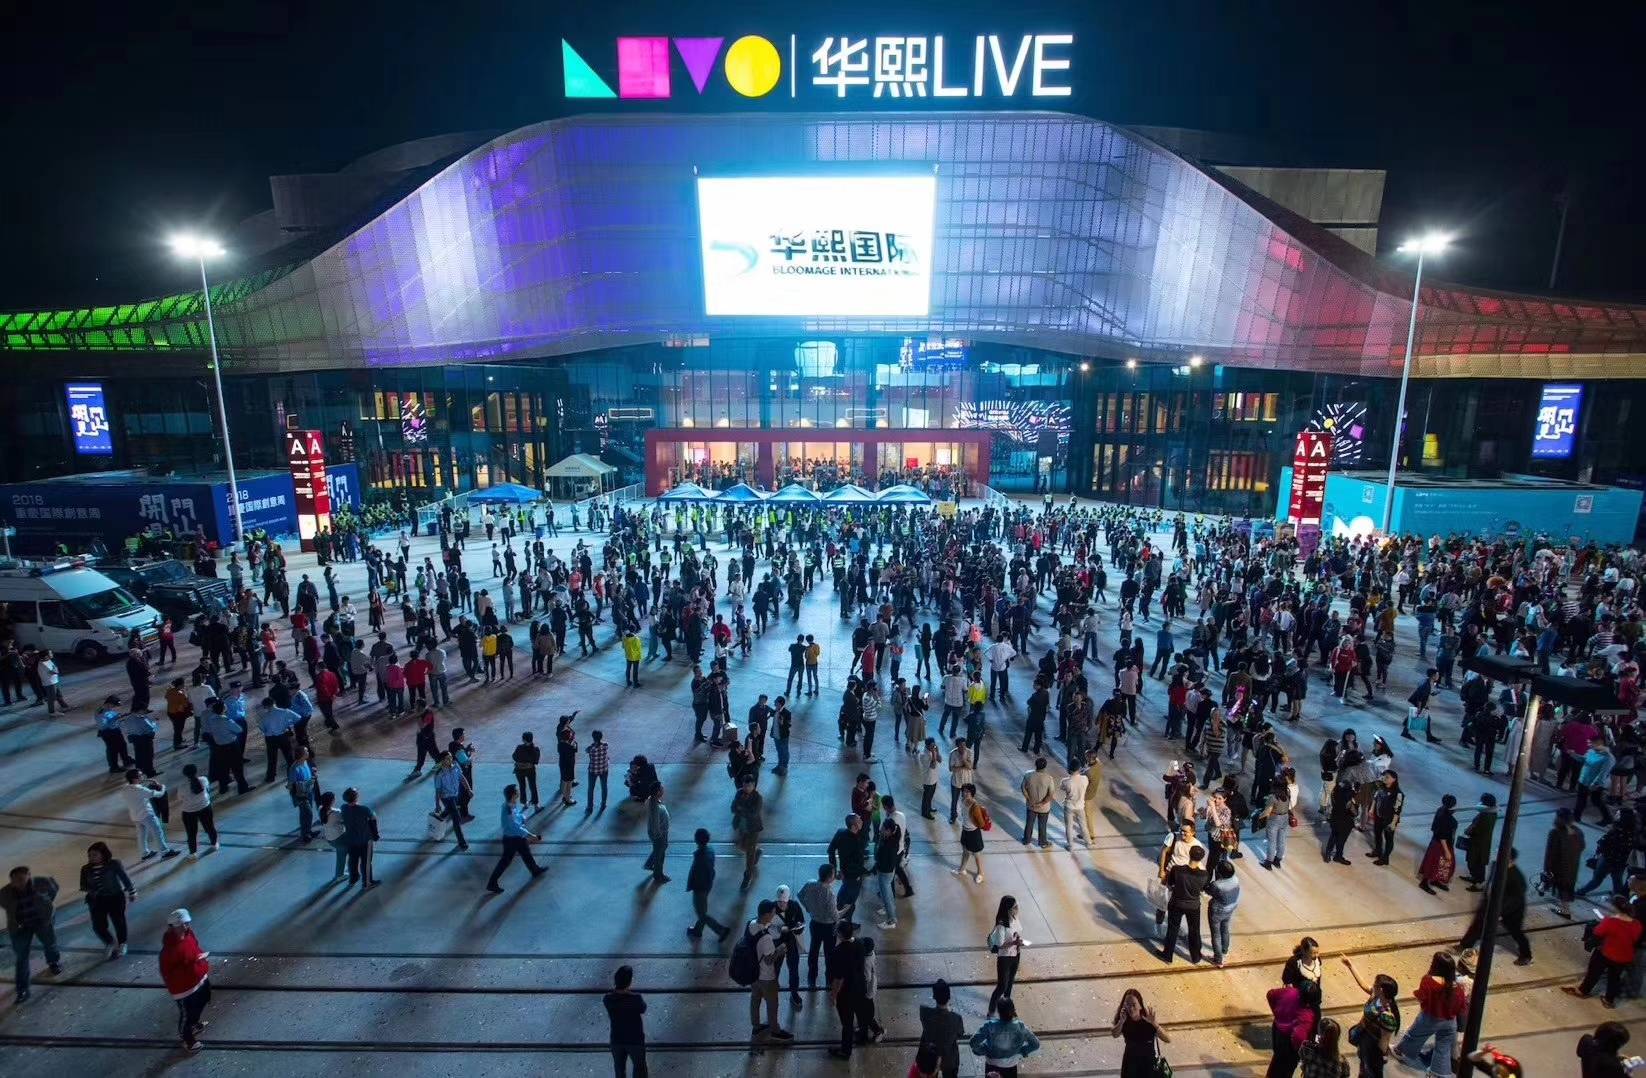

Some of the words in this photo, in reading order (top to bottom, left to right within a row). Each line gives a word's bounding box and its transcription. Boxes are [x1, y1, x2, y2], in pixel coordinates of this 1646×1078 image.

[769, 229, 919, 263] 华熙国际
[773, 265, 837, 276] BLOOMAGE
[291, 439, 306, 454] A
[311, 439, 321, 454] A
[1296, 440, 1305, 456] A
[1311, 441, 1326, 457] A
[12, 494, 44, 506] 2018
[225, 490, 249, 503] 218
